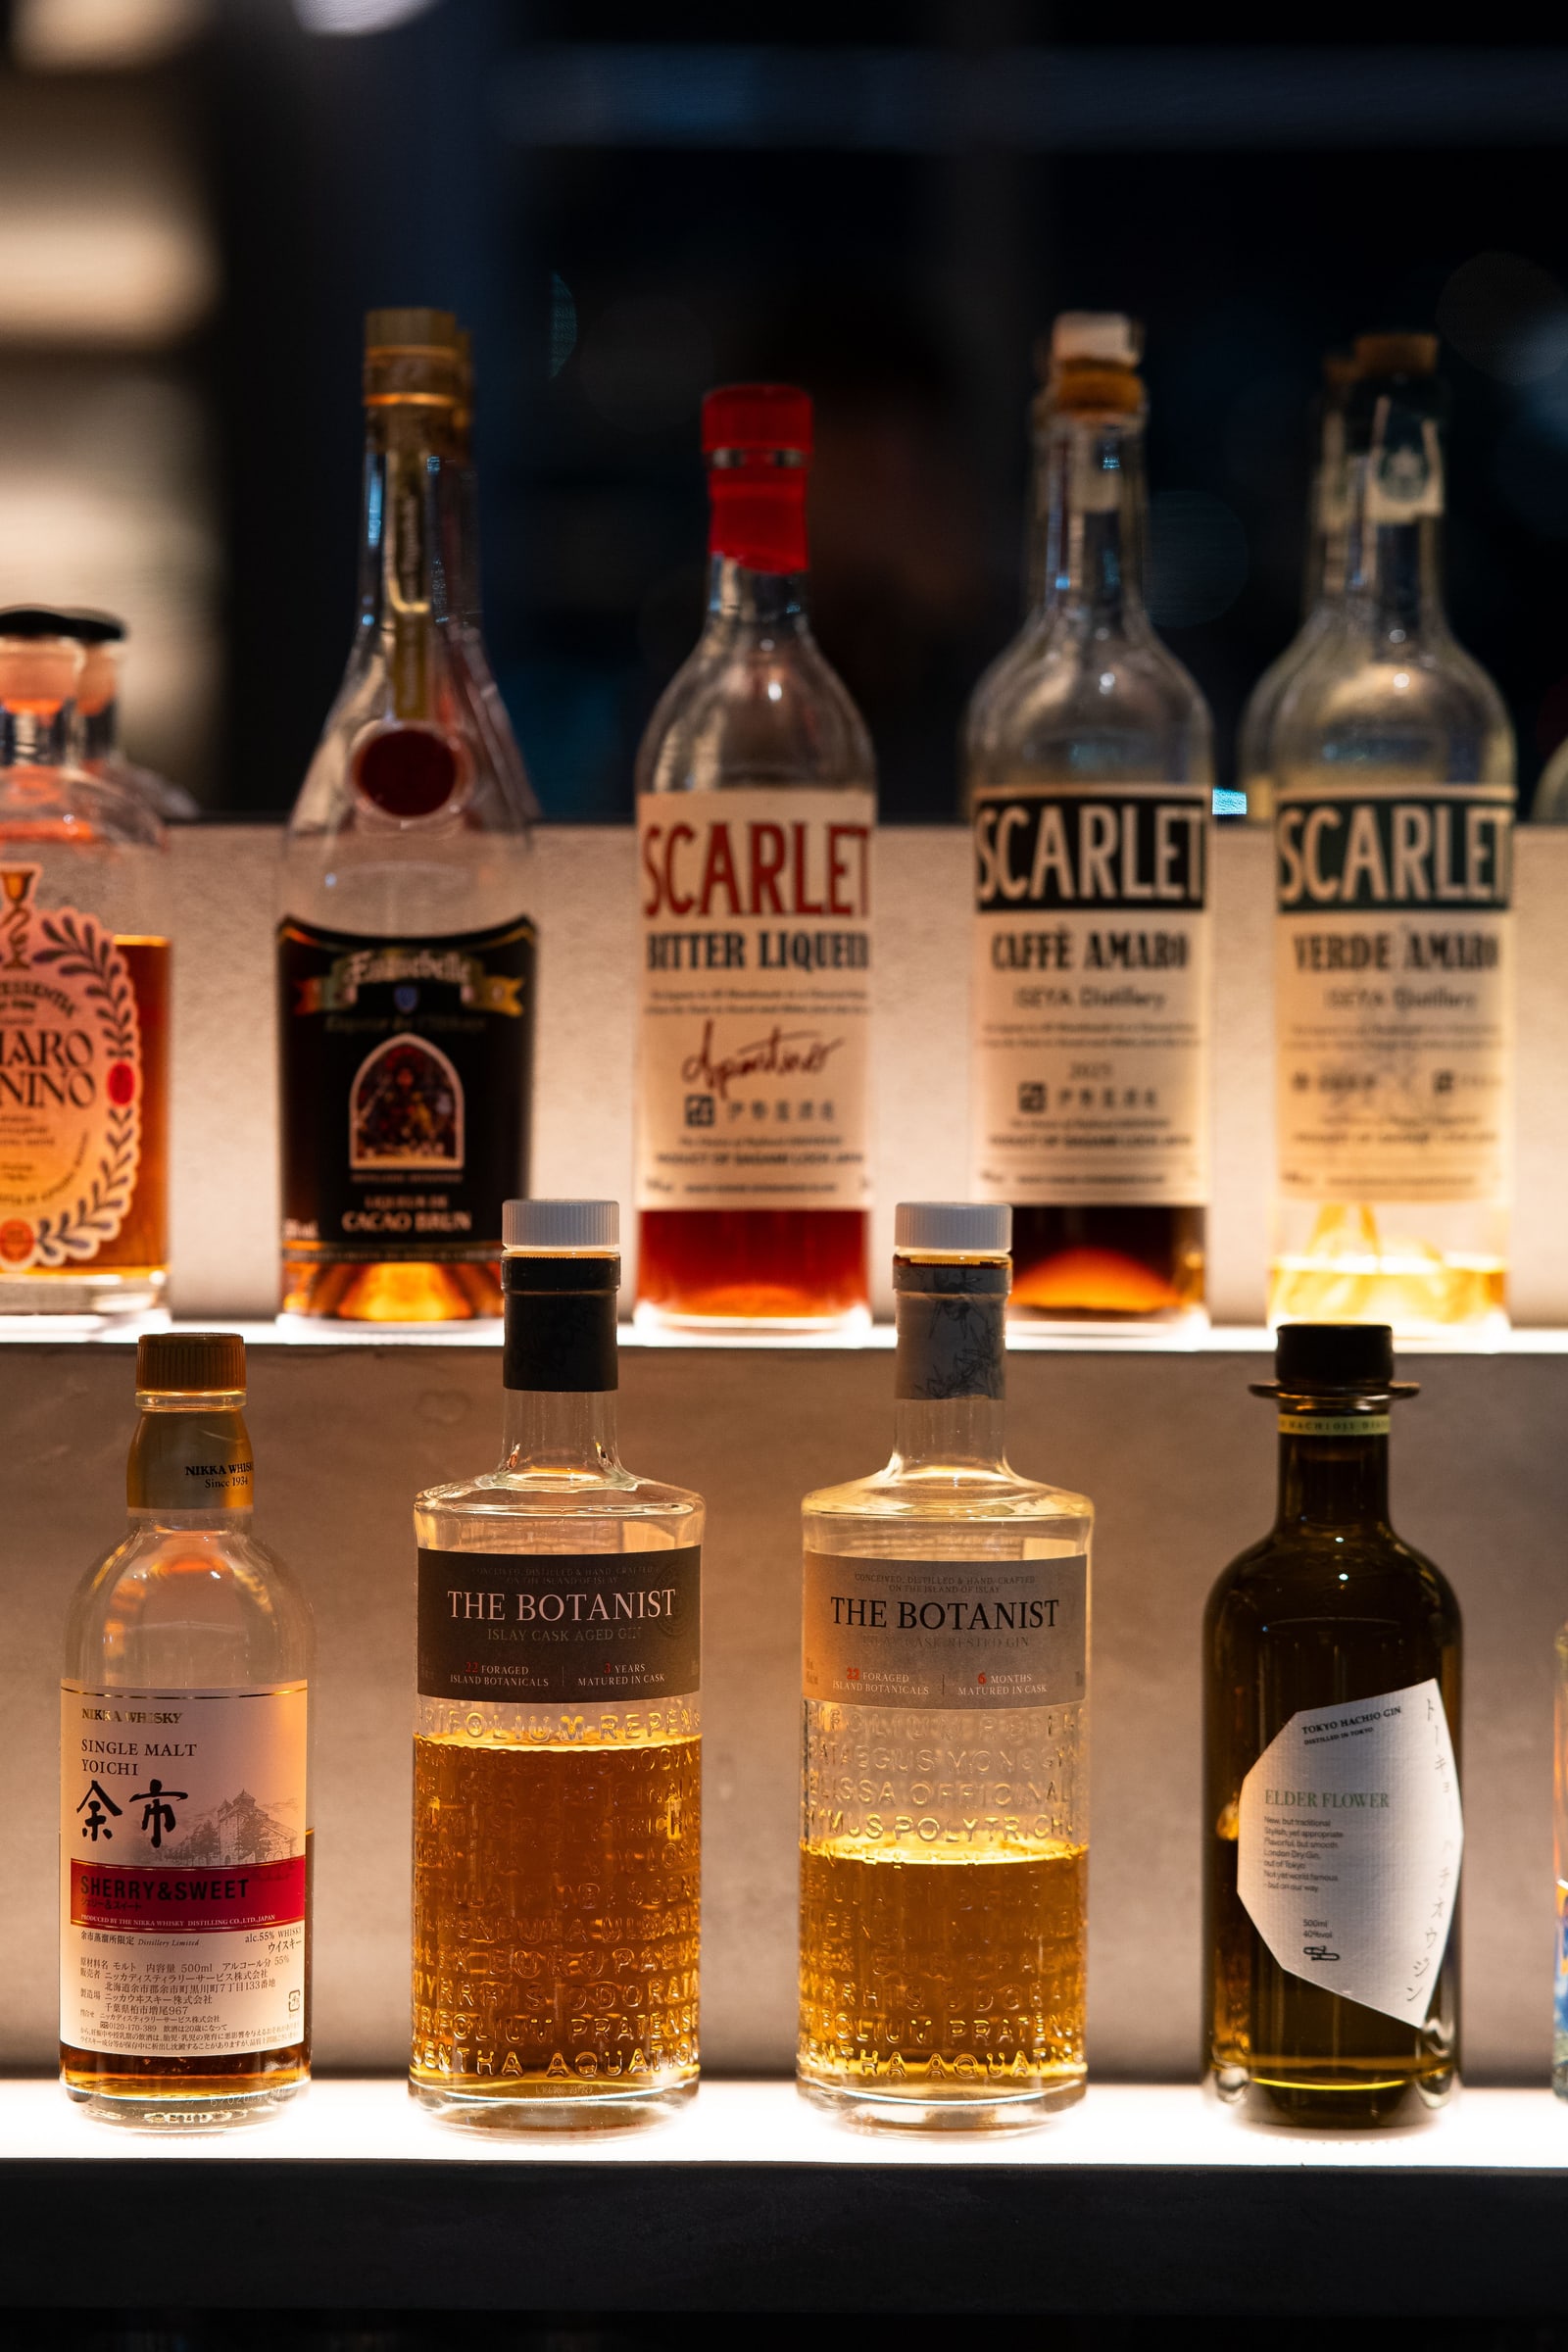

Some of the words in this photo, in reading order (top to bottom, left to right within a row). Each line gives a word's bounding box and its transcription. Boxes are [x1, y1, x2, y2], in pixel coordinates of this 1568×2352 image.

[976, 805, 1202, 900] SCARLET
[1277, 805, 1509, 902] SCARLET
[642, 821, 869, 918] SCARLET
[648, 932, 746, 970] BITTER
[991, 922, 1071, 971] CAFFÈ
[1083, 931, 1190, 971] AMARO
[185, 1464, 226, 1476] NIKKA
[205, 1478, 230, 1489] Since
[232, 1476, 248, 1486] 1934
[906, 1575, 955, 1585] DISTILLED
[956, 1576, 963, 1585] &
[889, 1584, 903, 1592] ON
[905, 1584, 922, 1593] THE
[924, 1585, 958, 1594] ISLAND
[961, 1585, 973, 1593] OF
[975, 1585, 1001, 1593] ISLAY
[447, 1591, 506, 1621] THE
[516, 1588, 676, 1622] BOTANIST
[830, 1595, 887, 1628] THE
[897, 1598, 1059, 1631] BOTANIST
[487, 1628, 527, 1642] ISLAY
[531, 1629, 569, 1642] CASK
[574, 1627, 613, 1642] AGED
[905, 1637, 941, 1647] CASK
[1005, 1637, 1029, 1647] GIN
[465, 1661, 478, 1673] 22
[481, 1665, 529, 1676] FORAGED
[604, 1662, 612, 1674] 3
[614, 1664, 646, 1674] YEARS
[846, 1667, 859, 1680] 22
[862, 1671, 909, 1683] FORAGED
[450, 1673, 482, 1685] ISLAND
[484, 1675, 549, 1687] BOTANICALS
[577, 1675, 628, 1687] MATURED
[631, 1674, 641, 1684] IN
[643, 1672, 665, 1683] CASK
[977, 1672, 986, 1685] 6
[991, 1674, 1032, 1683] MONTHS
[833, 1680, 862, 1691] ISLAND
[864, 1683, 929, 1694] BOTANICALS
[957, 1686, 1009, 1695] MATURED
[1012, 1685, 1022, 1693] IN
[1024, 1684, 1048, 1693] CASK
[81, 1708, 122, 1722] NIKKA
[124, 1710, 182, 1724] WHISKY
[1301, 1720, 1338, 1734] TOKYO
[1340, 1712, 1381, 1727] HACHIO
[1383, 1706, 1401, 1717] GIN
[1304, 1734, 1340, 1744] DISTILLED
[1349, 1727, 1374, 1737] TOKYO
[81, 1739, 138, 1756] SINGLE
[144, 1743, 197, 1757] MALT
[81, 1759, 139, 1776] YOICHI
[1265, 1788, 1318, 1808] ELDER
[1322, 1791, 1390, 1809] FLOWER
[76, 1779, 189, 1848] 余市
[1295, 1818, 1331, 1827] traditional
[1291, 1850, 1304, 1860] Dry
[1285, 1860, 1306, 1871] Tokyo
[1277, 1872, 1289, 1881] yet
[80, 1876, 249, 1901] SHERRY&SWEET
[1303, 1885, 1319, 1893] way
[80, 1914, 110, 1924] PRODUCED
[187, 1918, 228, 1927] DISTILLING
[1303, 1919, 1328, 1928] 500ml
[137, 1938, 170, 1947] Distillery
[245, 1931, 275, 1943] alc.55%
[268, 1938, 302, 1954] ウイスキー
[113, 1962, 136, 1973] モルト
[146, 1963, 176, 1974] 内容量
[180, 1963, 213, 1974] 500ml
[222, 1958, 271, 1972] アルコール分
[80, 1968, 100, 1980] 販売者
[105, 1969, 268, 1984] ニッカディスティラリーサービス株式会社
[105, 1993, 213, 2005] ニッカウヰスキー株式会社
[105, 2002, 189, 2016] 千葉県柏市増尾967
[109, 2022, 157, 2033] 0120-170-389
